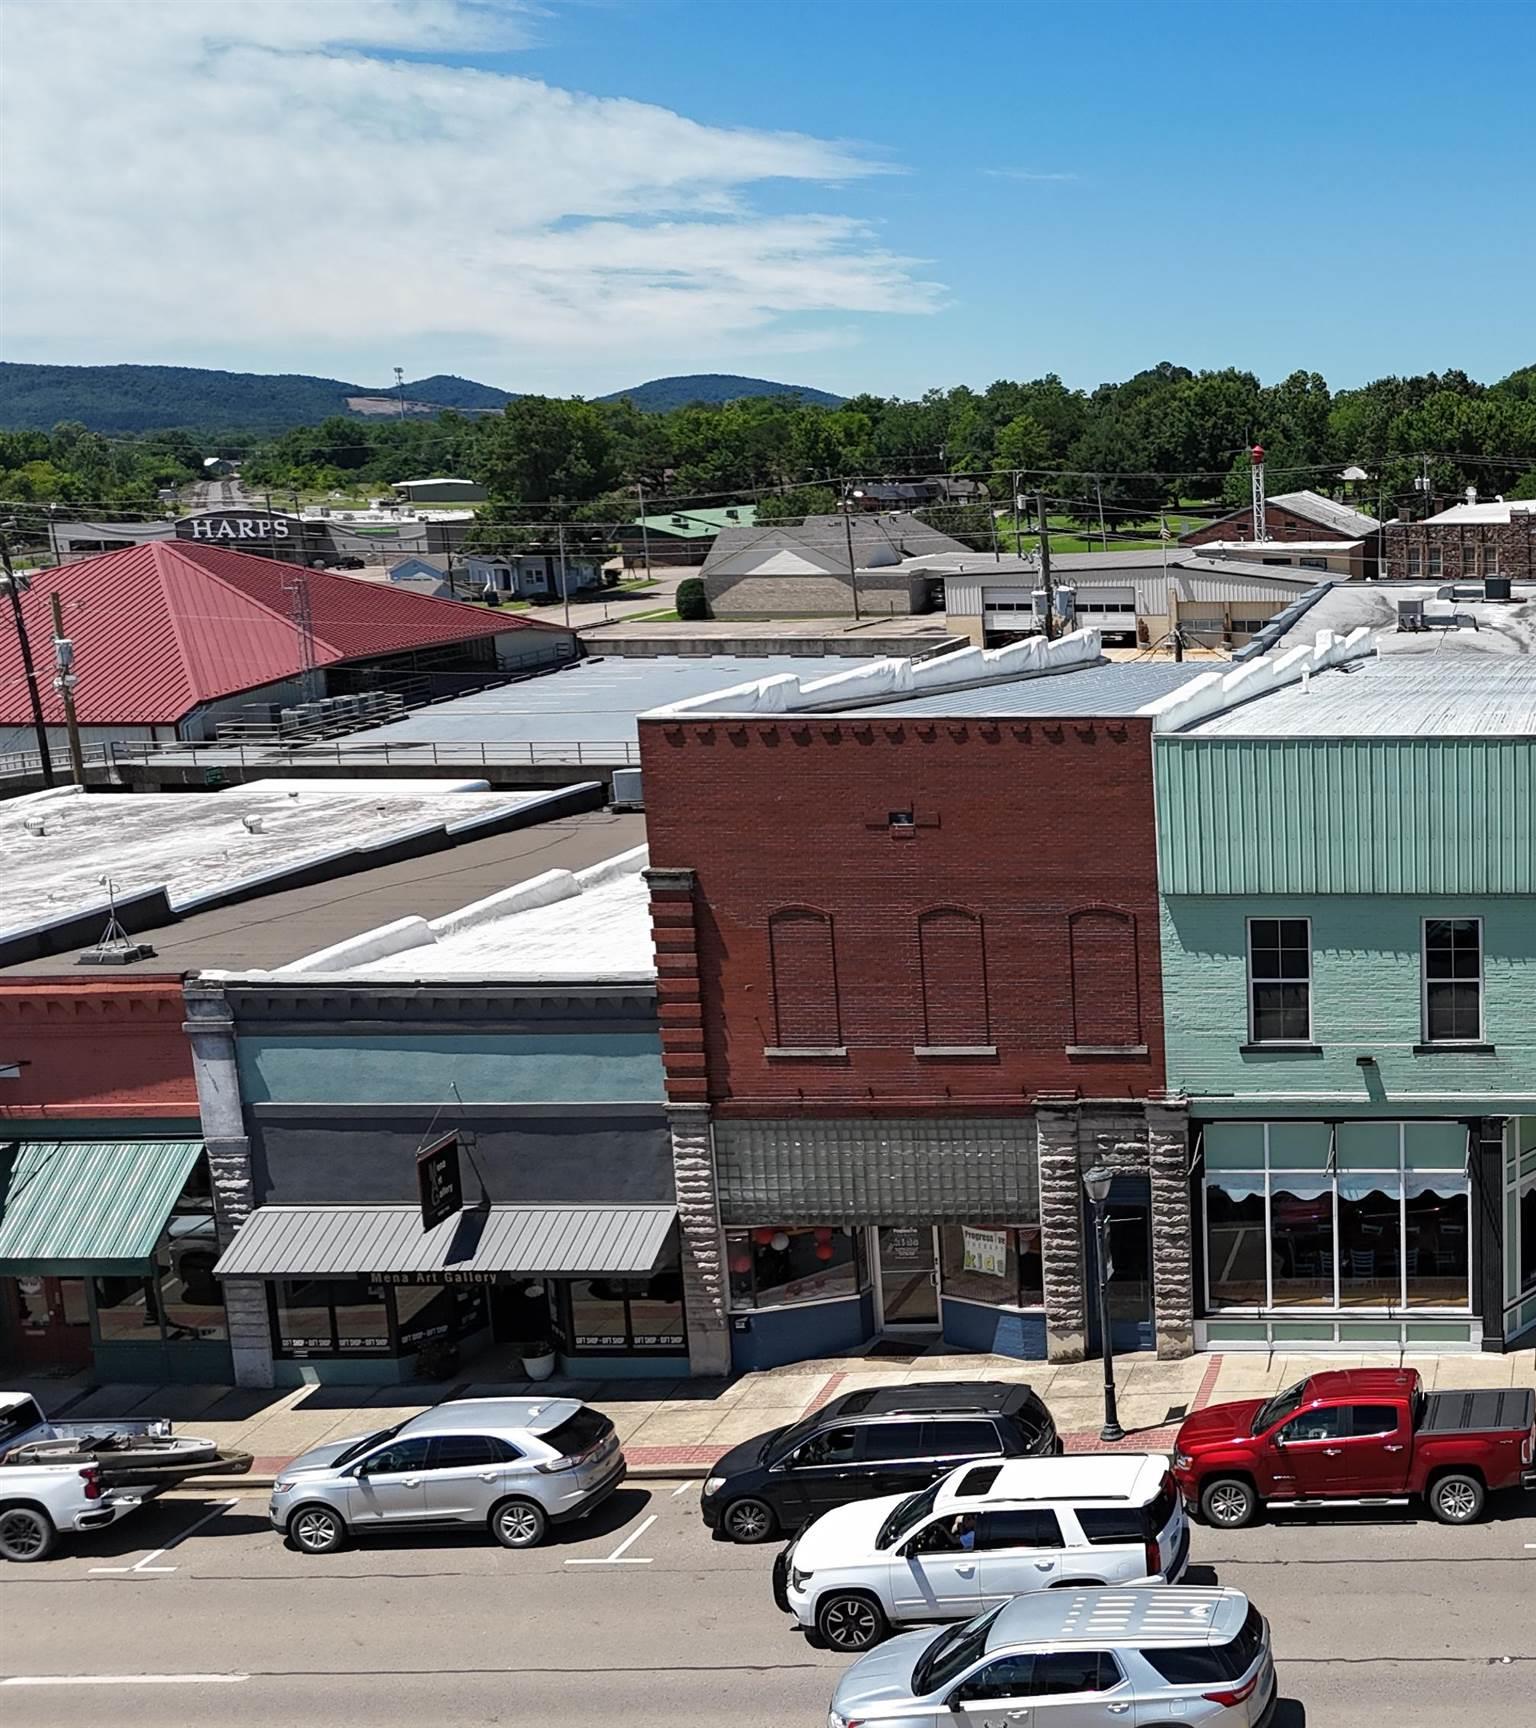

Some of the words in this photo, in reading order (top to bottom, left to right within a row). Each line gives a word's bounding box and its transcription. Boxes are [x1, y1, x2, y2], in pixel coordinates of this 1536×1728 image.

[190, 519, 289, 538] HARPS
[370, 1271, 409, 1283] Mena
[416, 1271, 438, 1283] Art
[444, 1271, 497, 1285] Gallery
